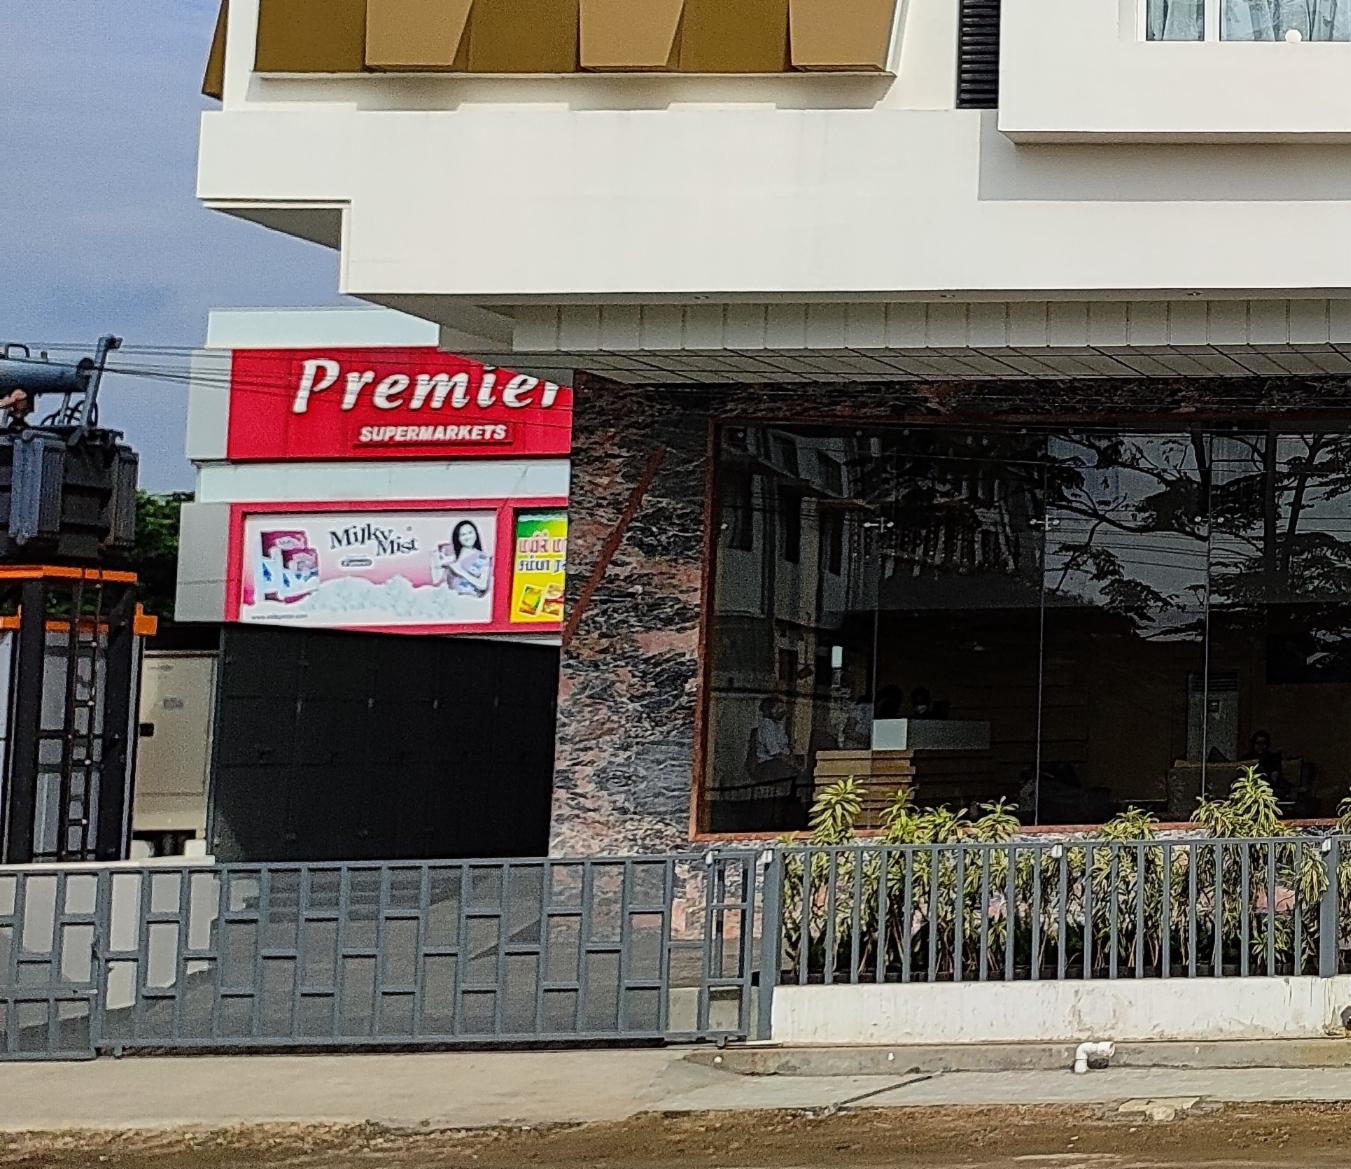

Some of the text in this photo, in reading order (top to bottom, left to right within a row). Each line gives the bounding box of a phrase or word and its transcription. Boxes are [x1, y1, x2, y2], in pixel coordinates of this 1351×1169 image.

[292, 358, 559, 414] Premier
[358, 424, 507, 443] SUPERMARKETS
[329, 523, 394, 550] Milky
[376, 536, 419, 557] Mist
